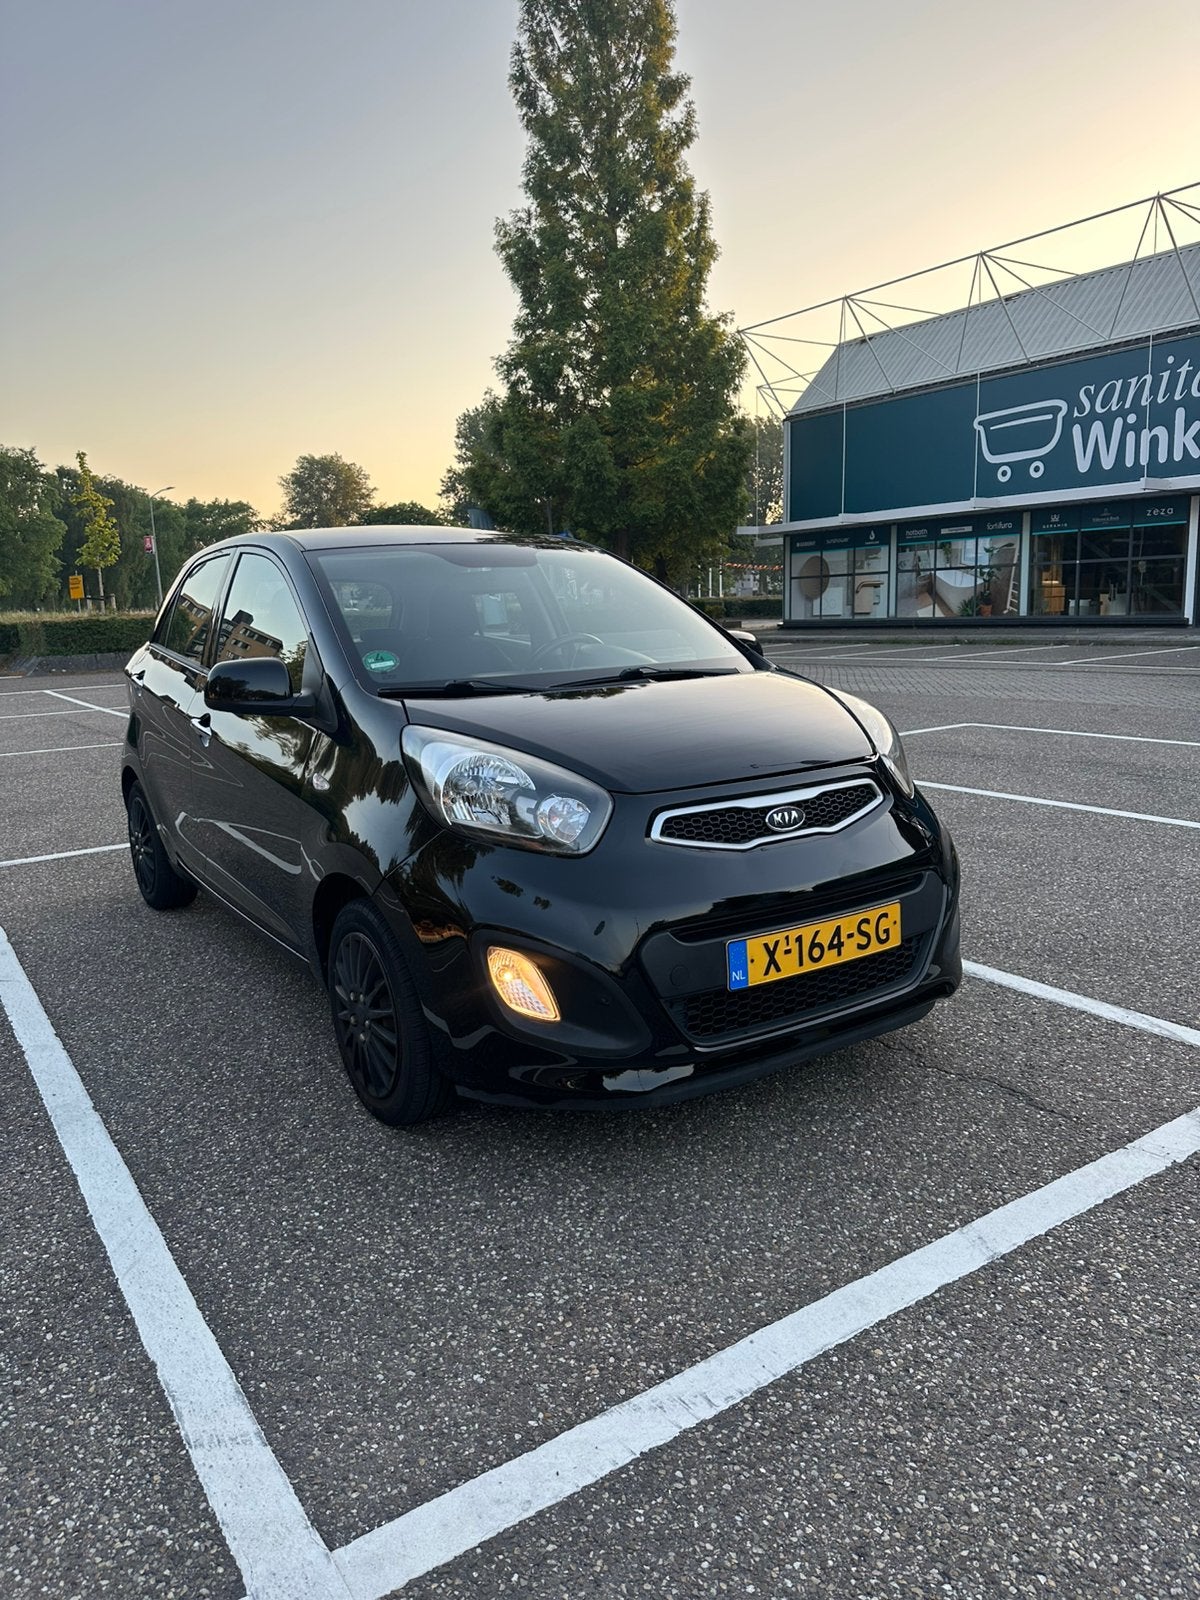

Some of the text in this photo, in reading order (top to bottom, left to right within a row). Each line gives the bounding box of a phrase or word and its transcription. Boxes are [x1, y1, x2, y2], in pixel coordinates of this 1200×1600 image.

[1072, 407, 1200, 473] Wink
[1146, 506, 1174, 517] zeza
[772, 810, 799, 827] KIA
[731, 969, 747, 982] NL
